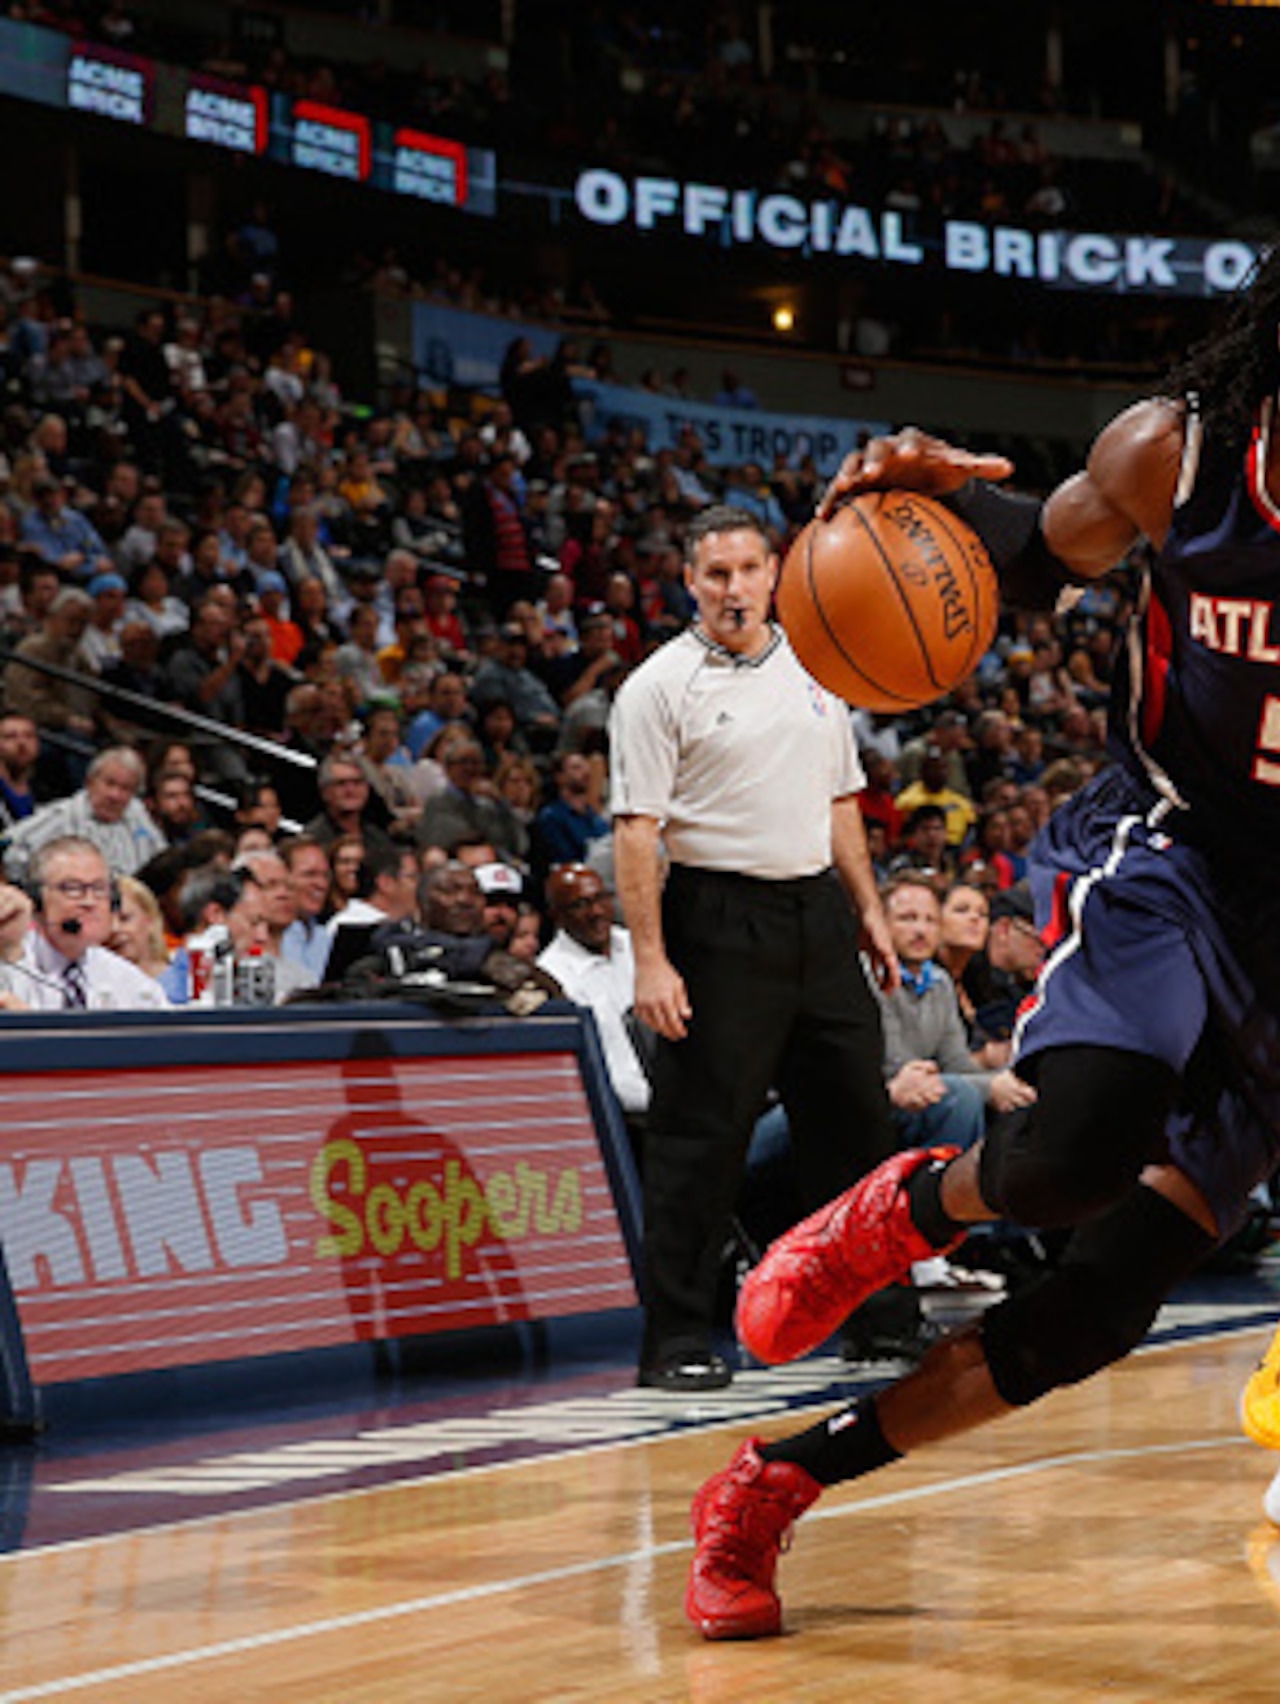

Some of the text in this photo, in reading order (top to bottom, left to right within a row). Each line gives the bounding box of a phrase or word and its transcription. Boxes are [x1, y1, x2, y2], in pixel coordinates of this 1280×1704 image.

[574, 168, 923, 264] OFFICIAL
[944, 220, 1177, 288] BRICK
[0, 1138, 584, 1290] KING Soopers
